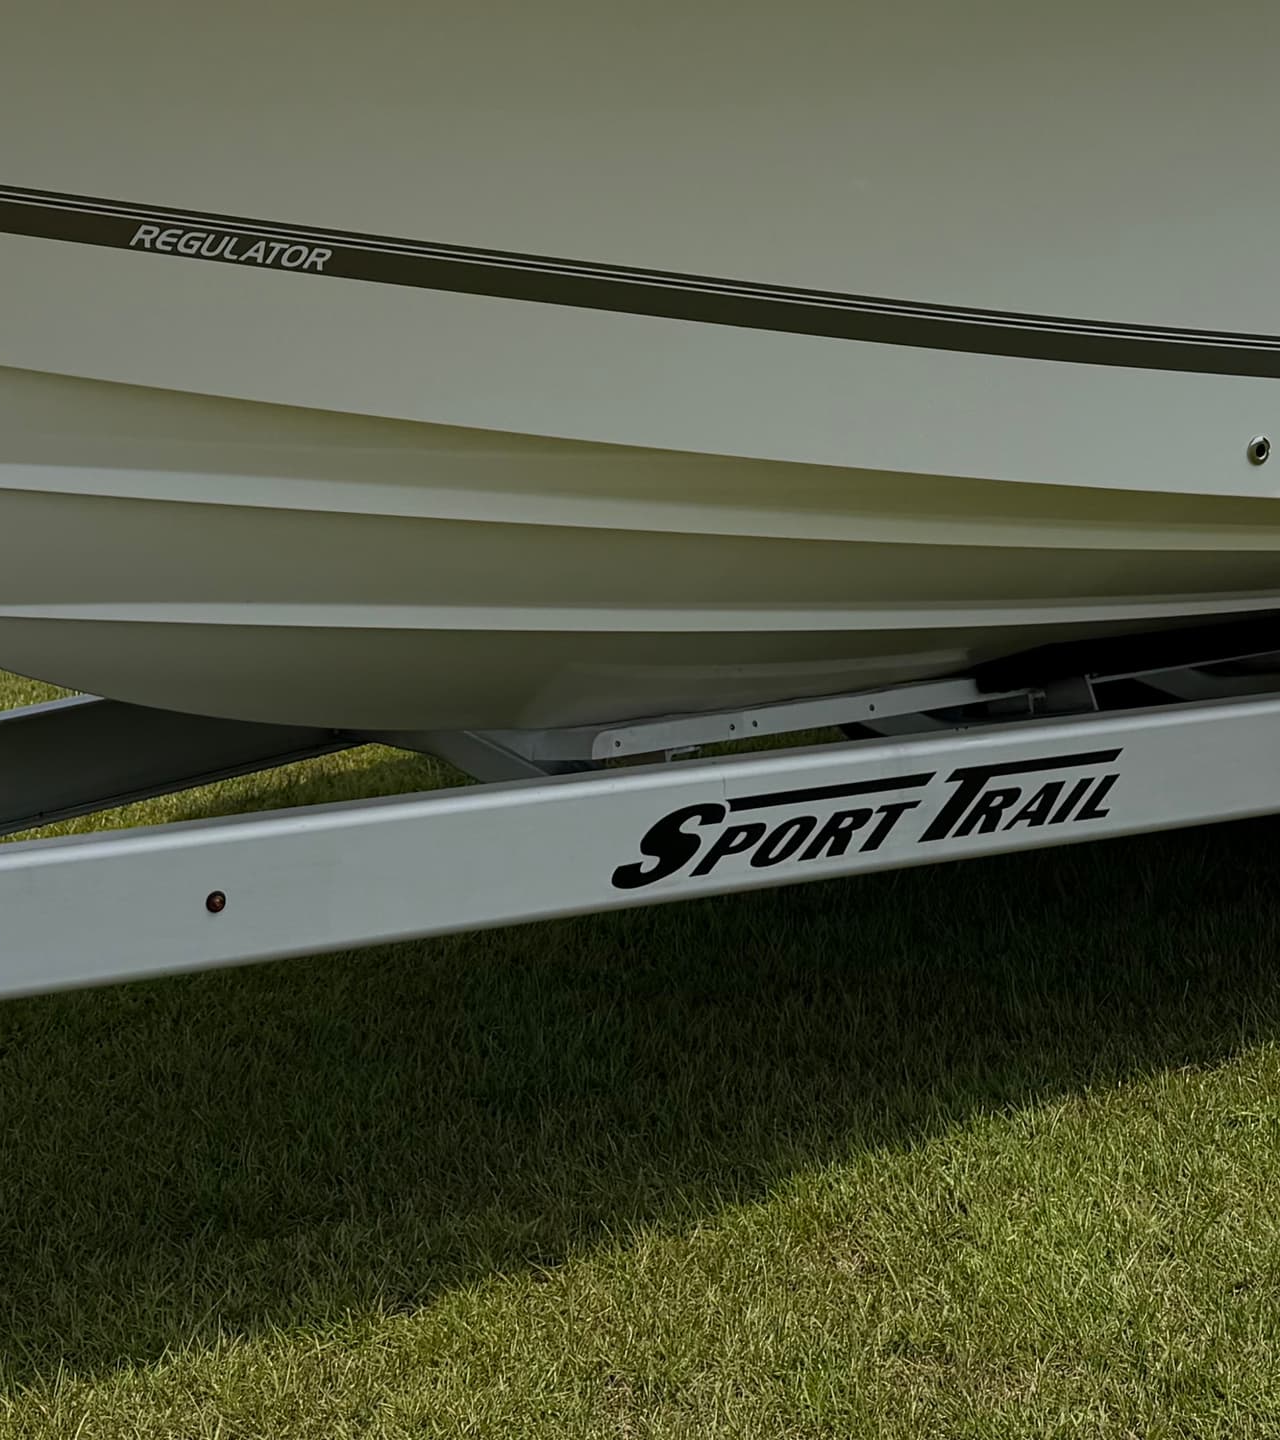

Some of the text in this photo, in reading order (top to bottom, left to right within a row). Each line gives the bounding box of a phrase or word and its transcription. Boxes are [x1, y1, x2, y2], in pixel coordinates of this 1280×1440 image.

[129, 224, 332, 271] REGULATOR
[611, 747, 1124, 890] SPORT TRAIL
